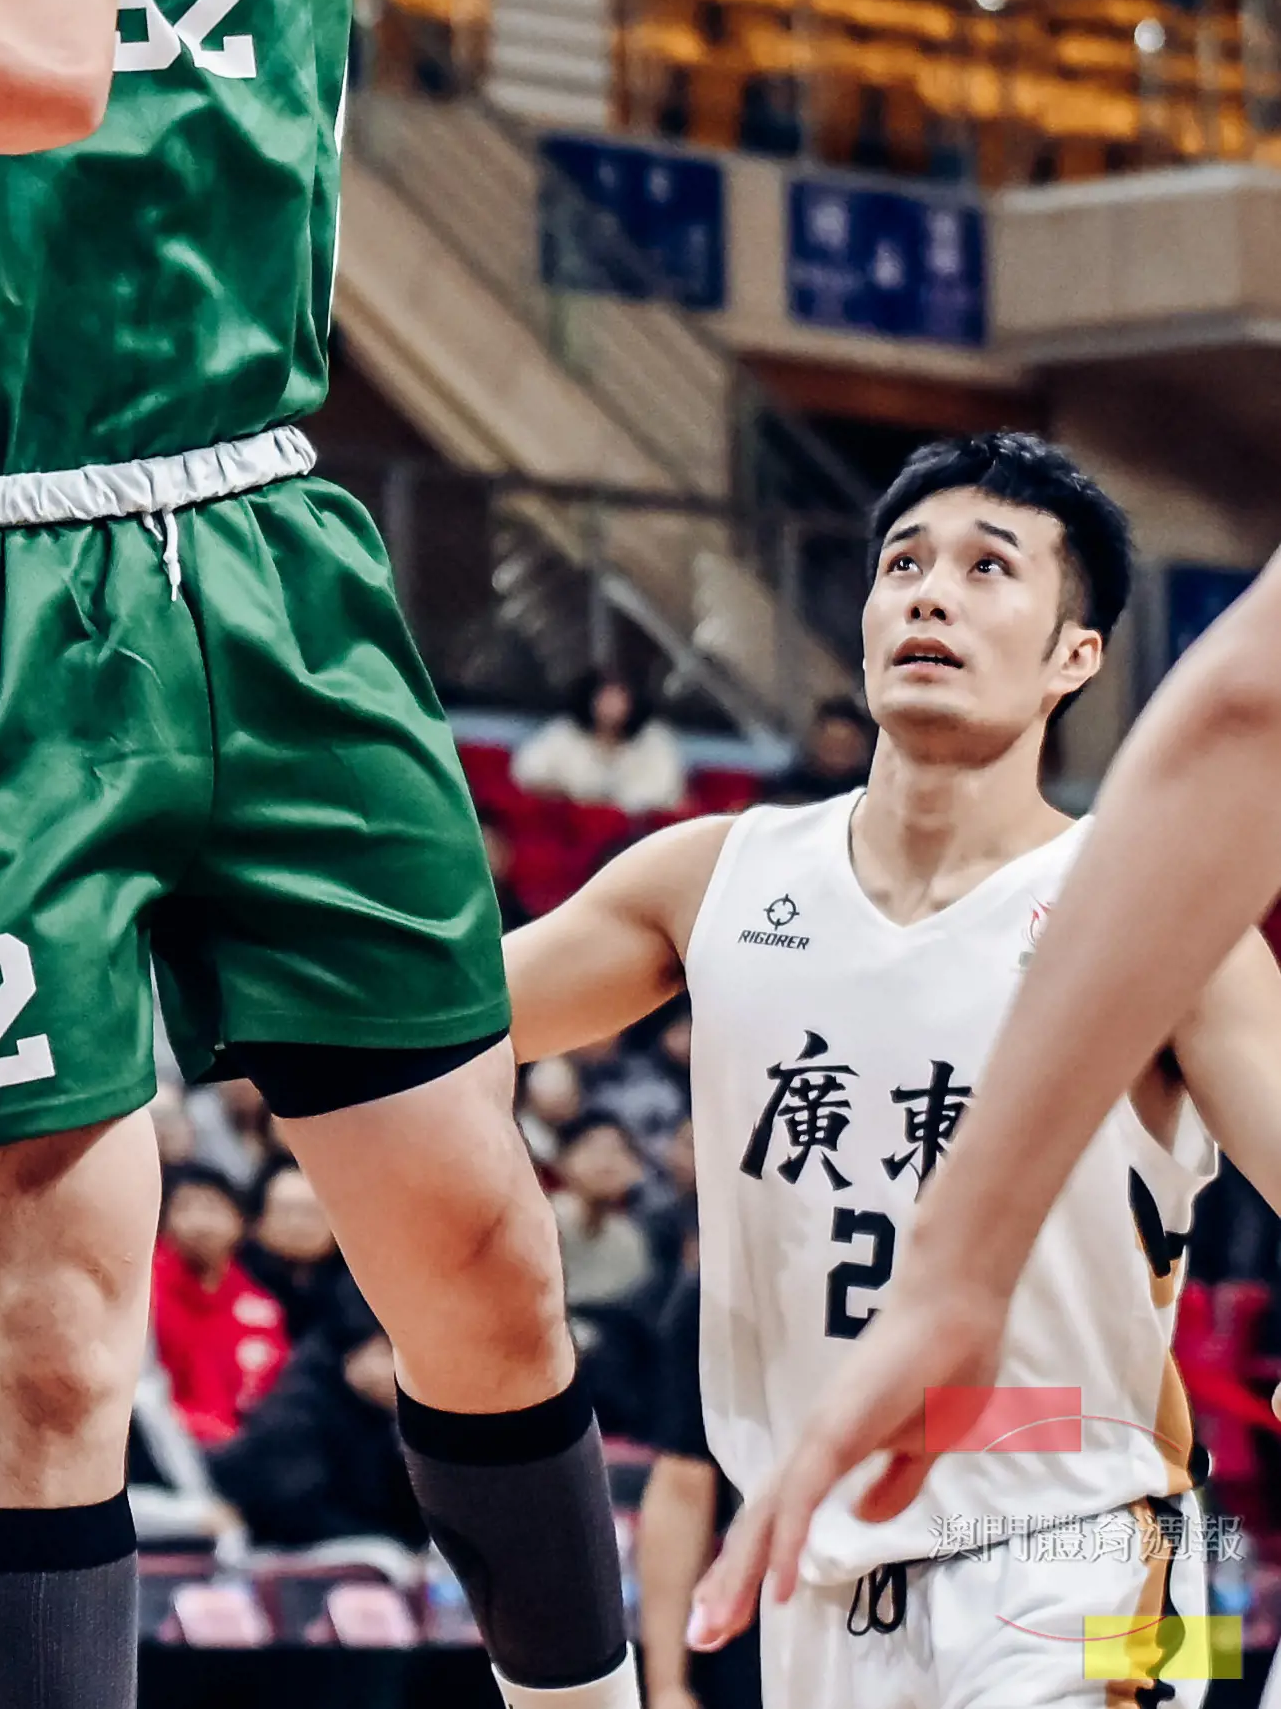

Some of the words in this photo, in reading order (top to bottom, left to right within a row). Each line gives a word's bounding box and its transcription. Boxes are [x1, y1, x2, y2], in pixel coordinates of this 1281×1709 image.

[737, 929, 811, 950] RIGORER
[739, 1029, 976, 1194] 廣東
[824, 1206, 896, 1340] 2
